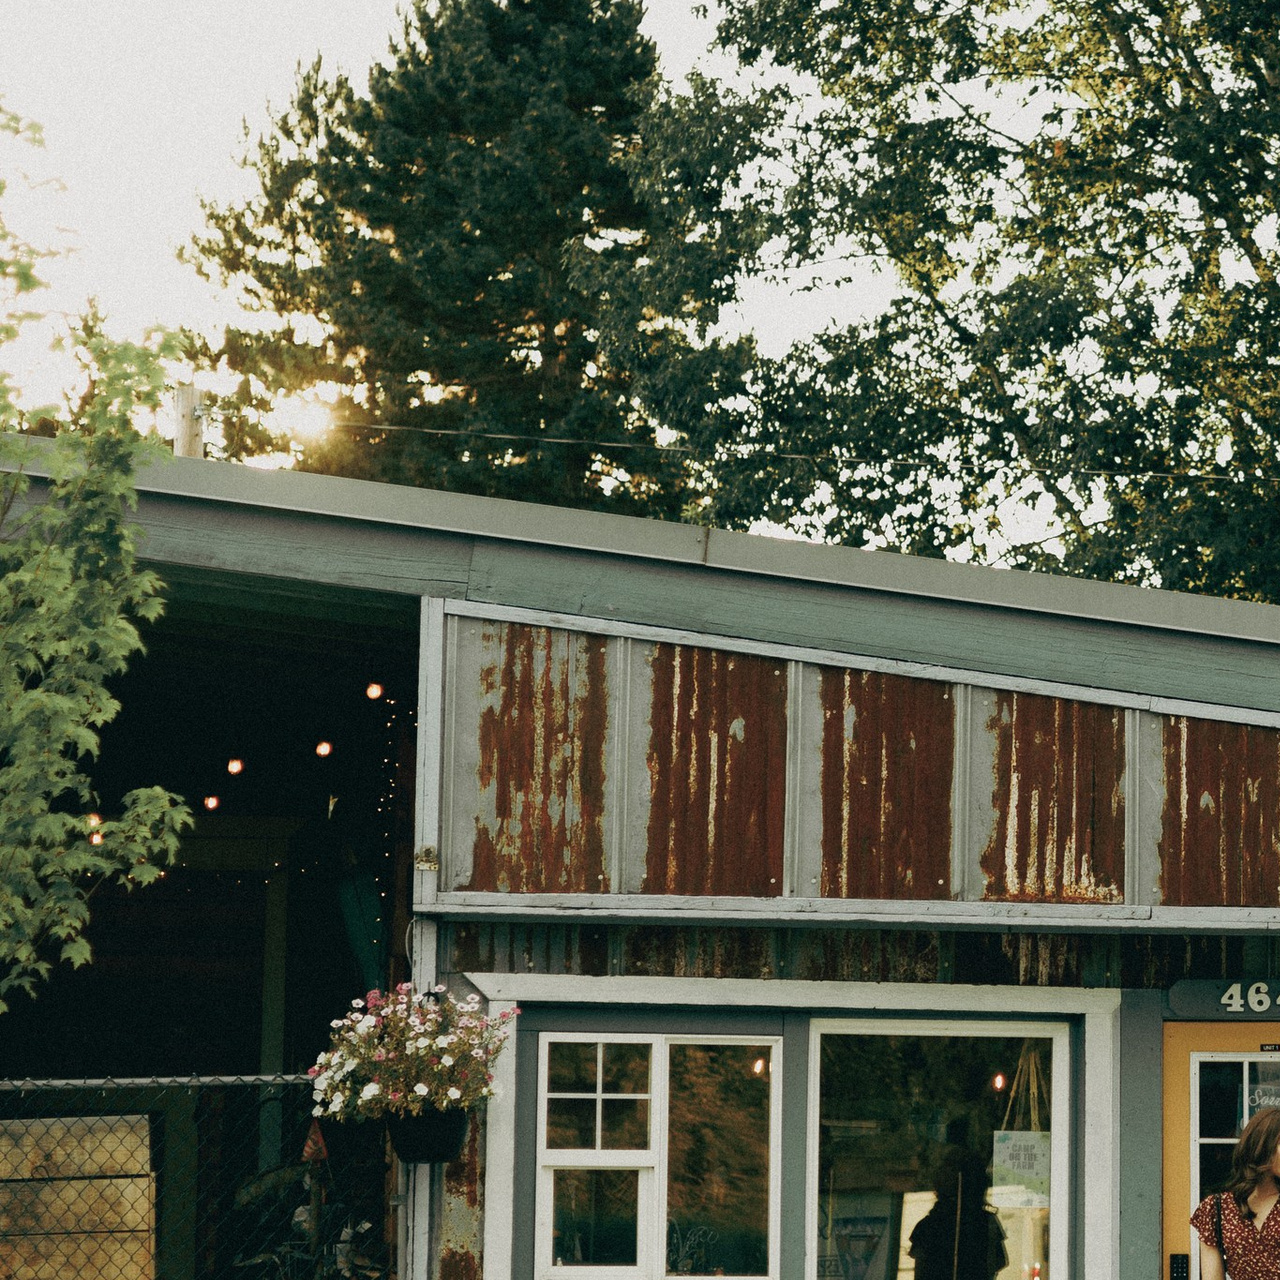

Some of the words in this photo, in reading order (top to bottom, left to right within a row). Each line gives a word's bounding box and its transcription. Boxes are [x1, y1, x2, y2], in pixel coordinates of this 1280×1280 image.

[1011, 1144, 1035, 1152] CAMP
[1023, 1152, 1039, 1161] THE
[1011, 1161, 1035, 1170] FARM
